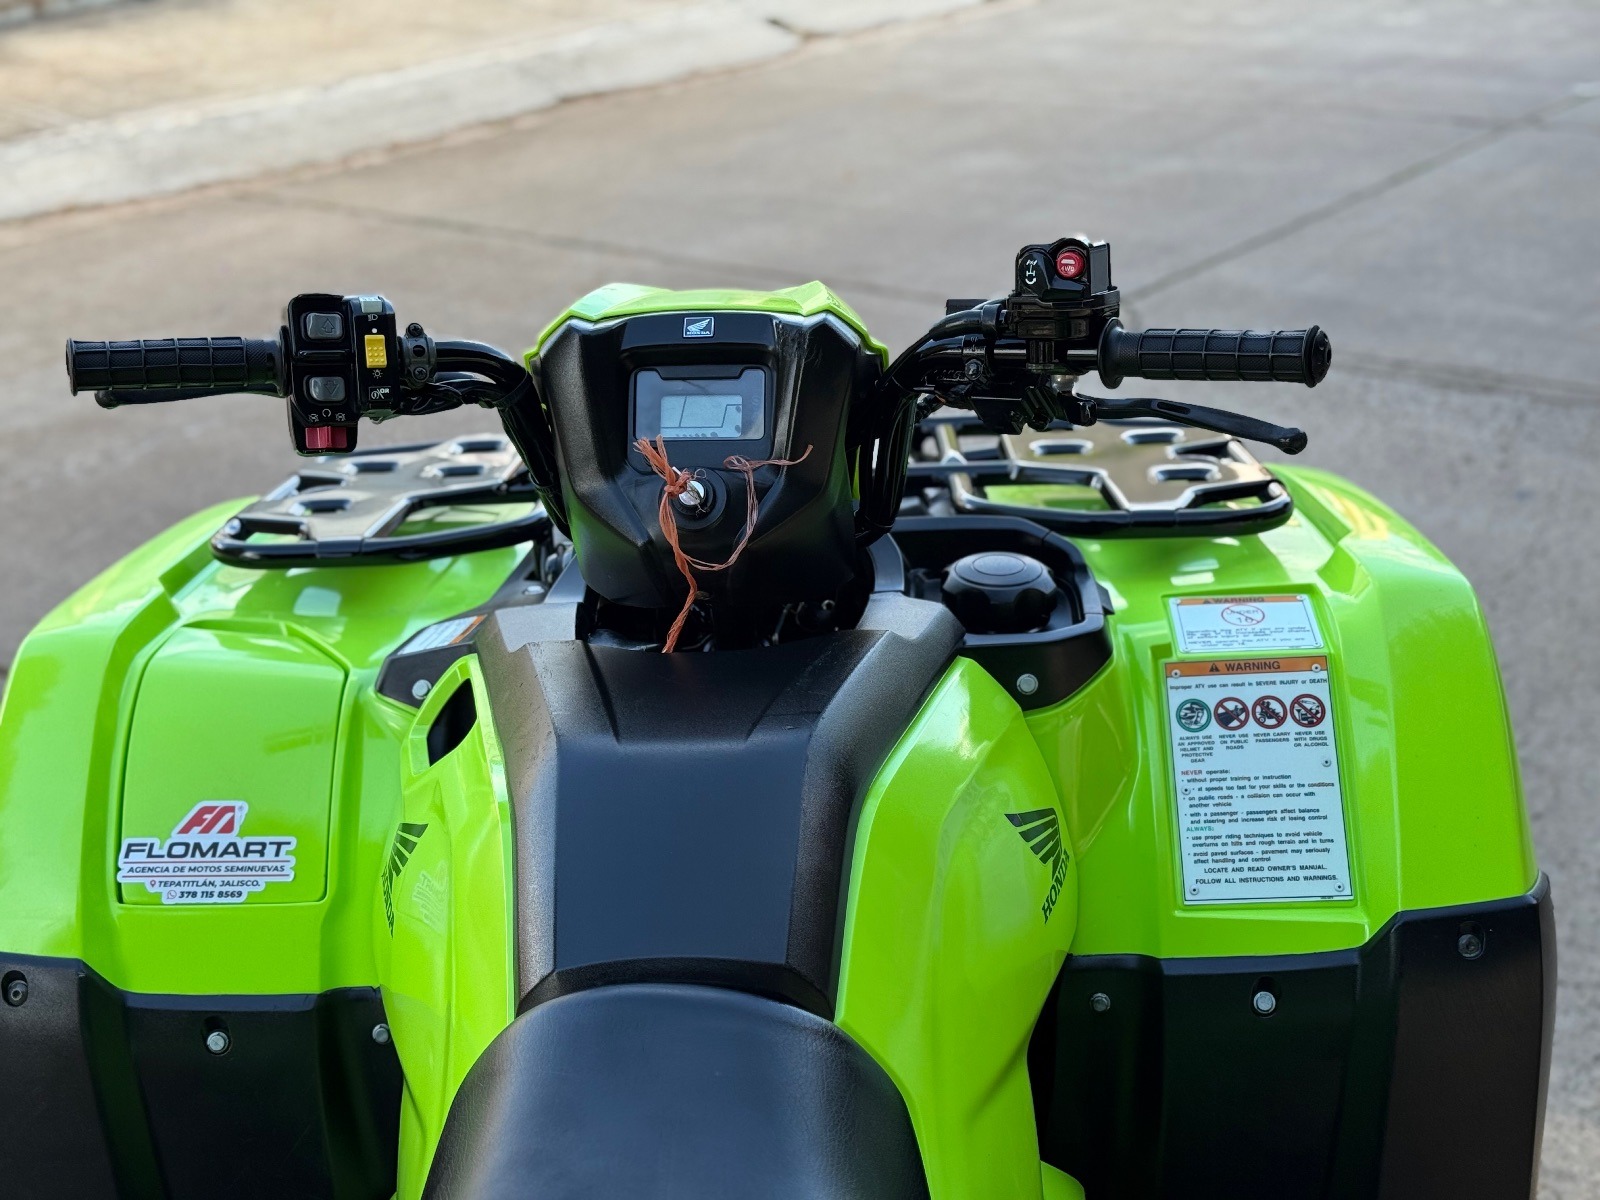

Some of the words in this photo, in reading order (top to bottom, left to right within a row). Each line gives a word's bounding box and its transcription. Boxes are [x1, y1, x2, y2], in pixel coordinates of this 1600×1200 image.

[1225, 661, 1280, 672] WARNING
[124, 842, 292, 859] FLOMART
[158, 878, 217, 888] TEPATITLÁN,
[220, 879, 260, 887] JALISCO.
